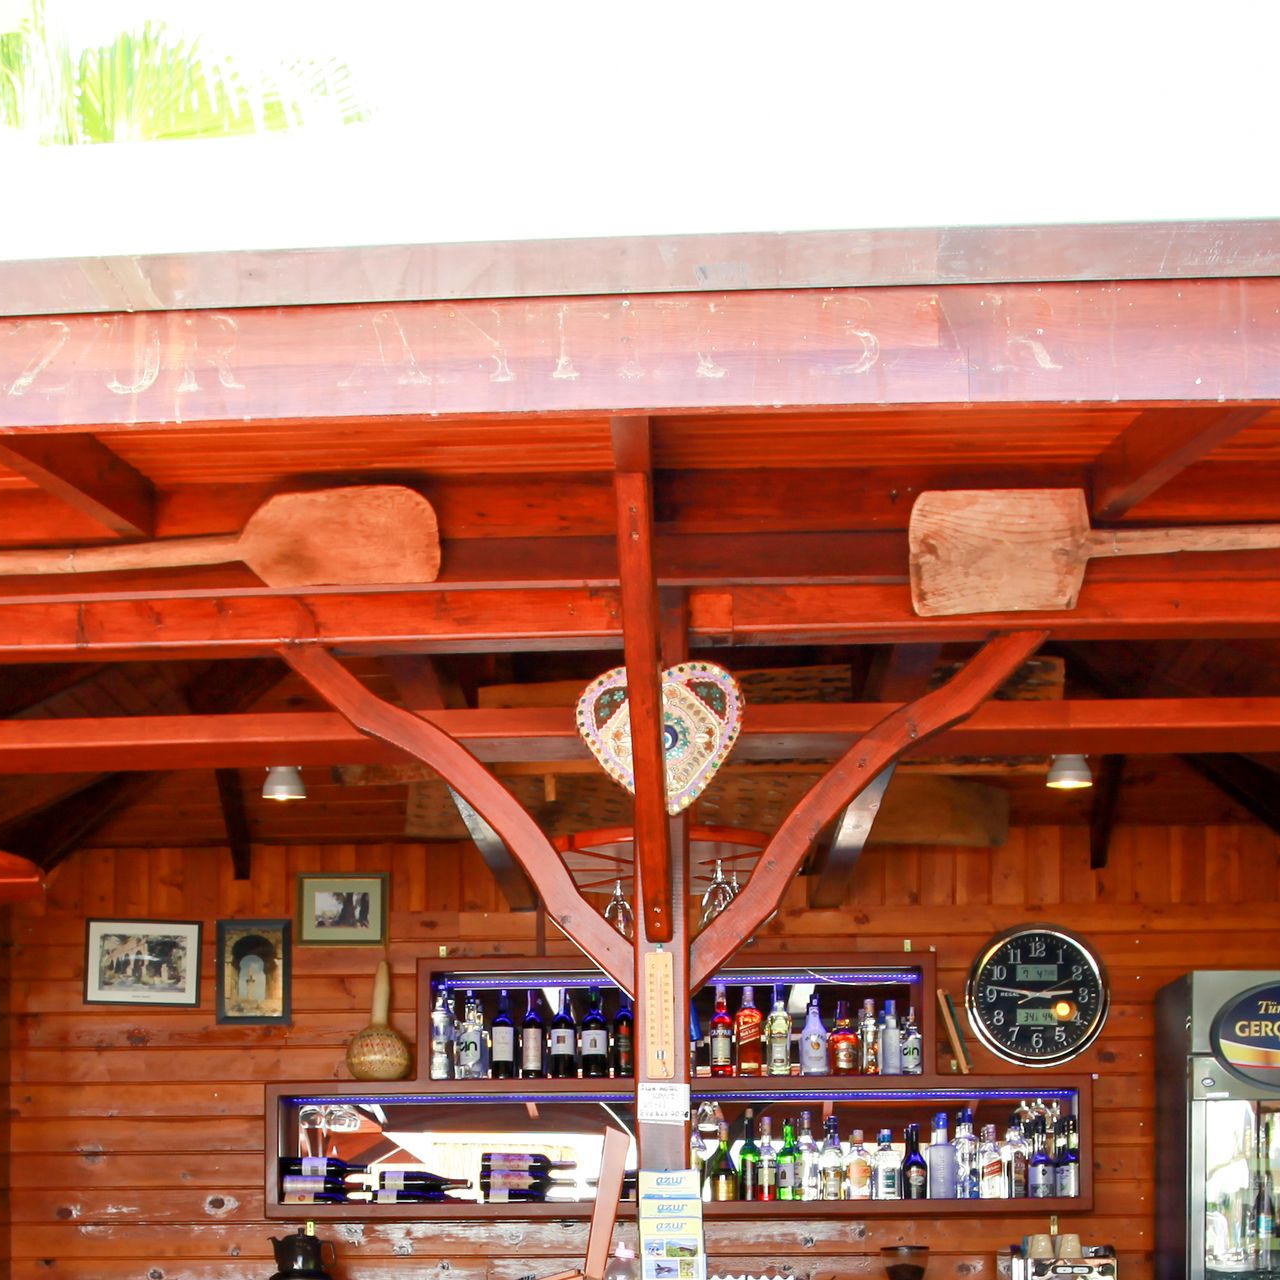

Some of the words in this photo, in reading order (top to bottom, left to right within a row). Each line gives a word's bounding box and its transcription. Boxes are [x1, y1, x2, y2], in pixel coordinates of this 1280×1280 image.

[1008, 949, 1022, 964] 11
[1029, 942, 1046, 957] 12
[1057, 949, 1064, 964] 1
[992, 965, 1007, 981] 10
[1072, 965, 1083, 981] 2
[986, 987, 997, 1003] 9
[1078, 987, 1089, 1003] 3
[993, 1010, 1004, 1025] 8
[1072, 1011, 1083, 1025] 4
[1008, 1027, 1020, 1041] 7
[1032, 1032, 1043, 1048] 6
[1055, 1027, 1066, 1042] 5
